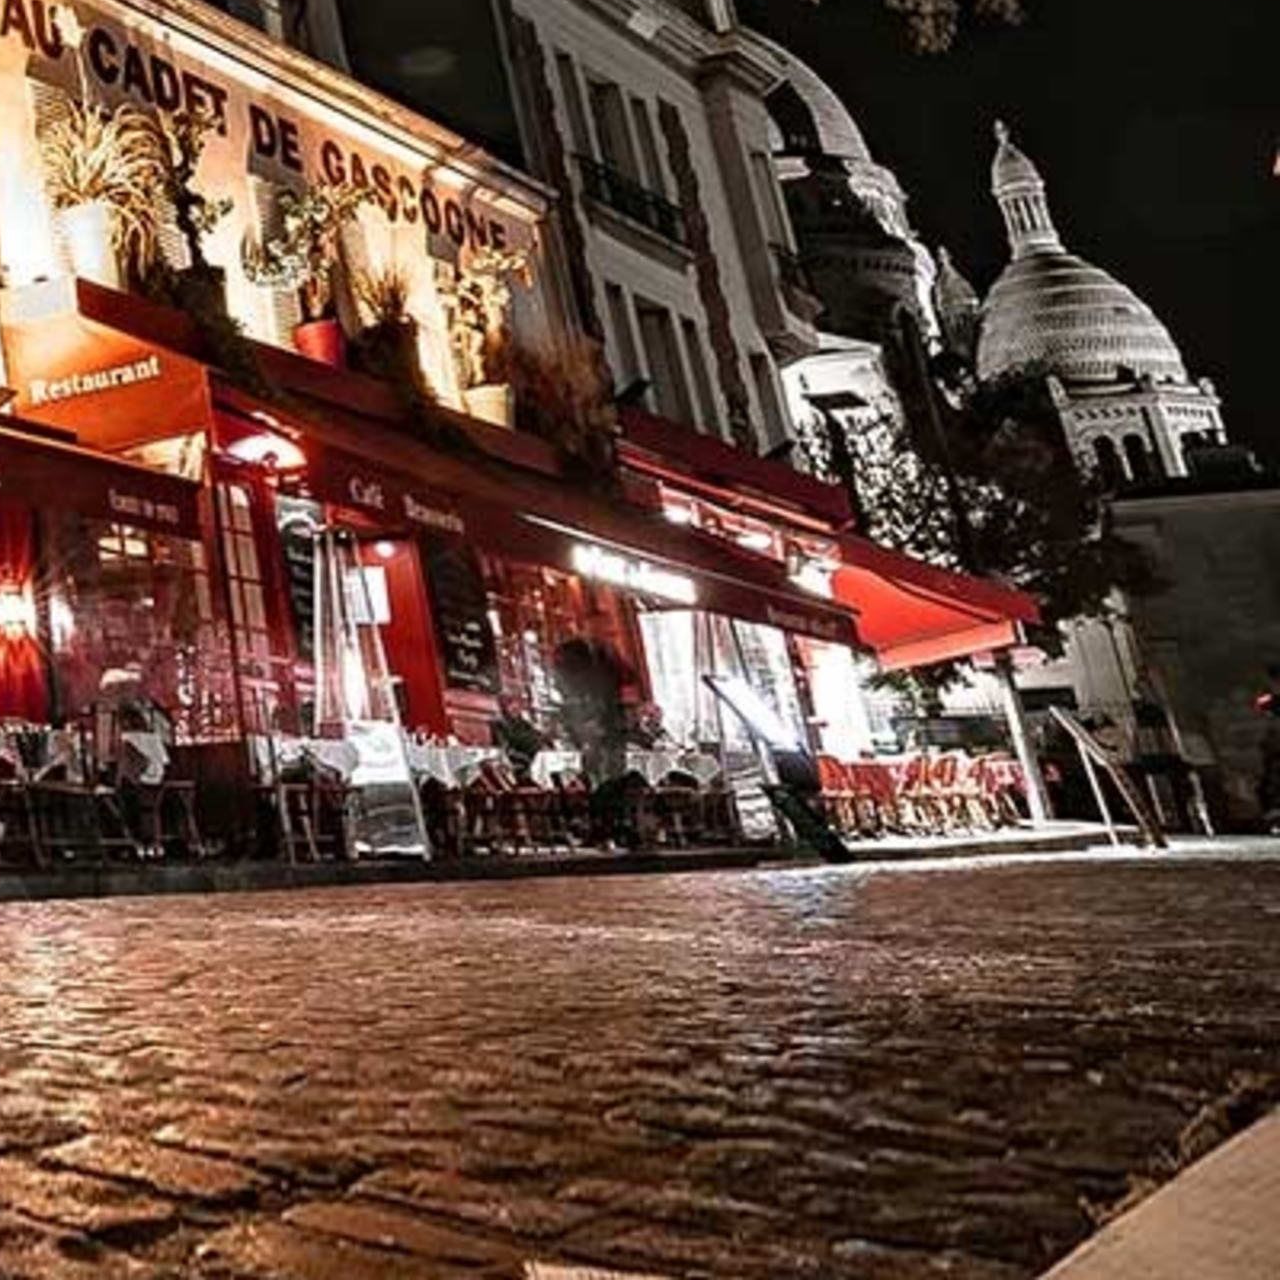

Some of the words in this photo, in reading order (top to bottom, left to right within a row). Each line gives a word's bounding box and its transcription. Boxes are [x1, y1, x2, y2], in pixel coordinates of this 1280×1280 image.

[88, 26, 229, 138] CADET
[248, 104, 304, 172] DE
[320, 139, 508, 251] GASCOGNE
[27, 354, 162, 407] Restaurant
